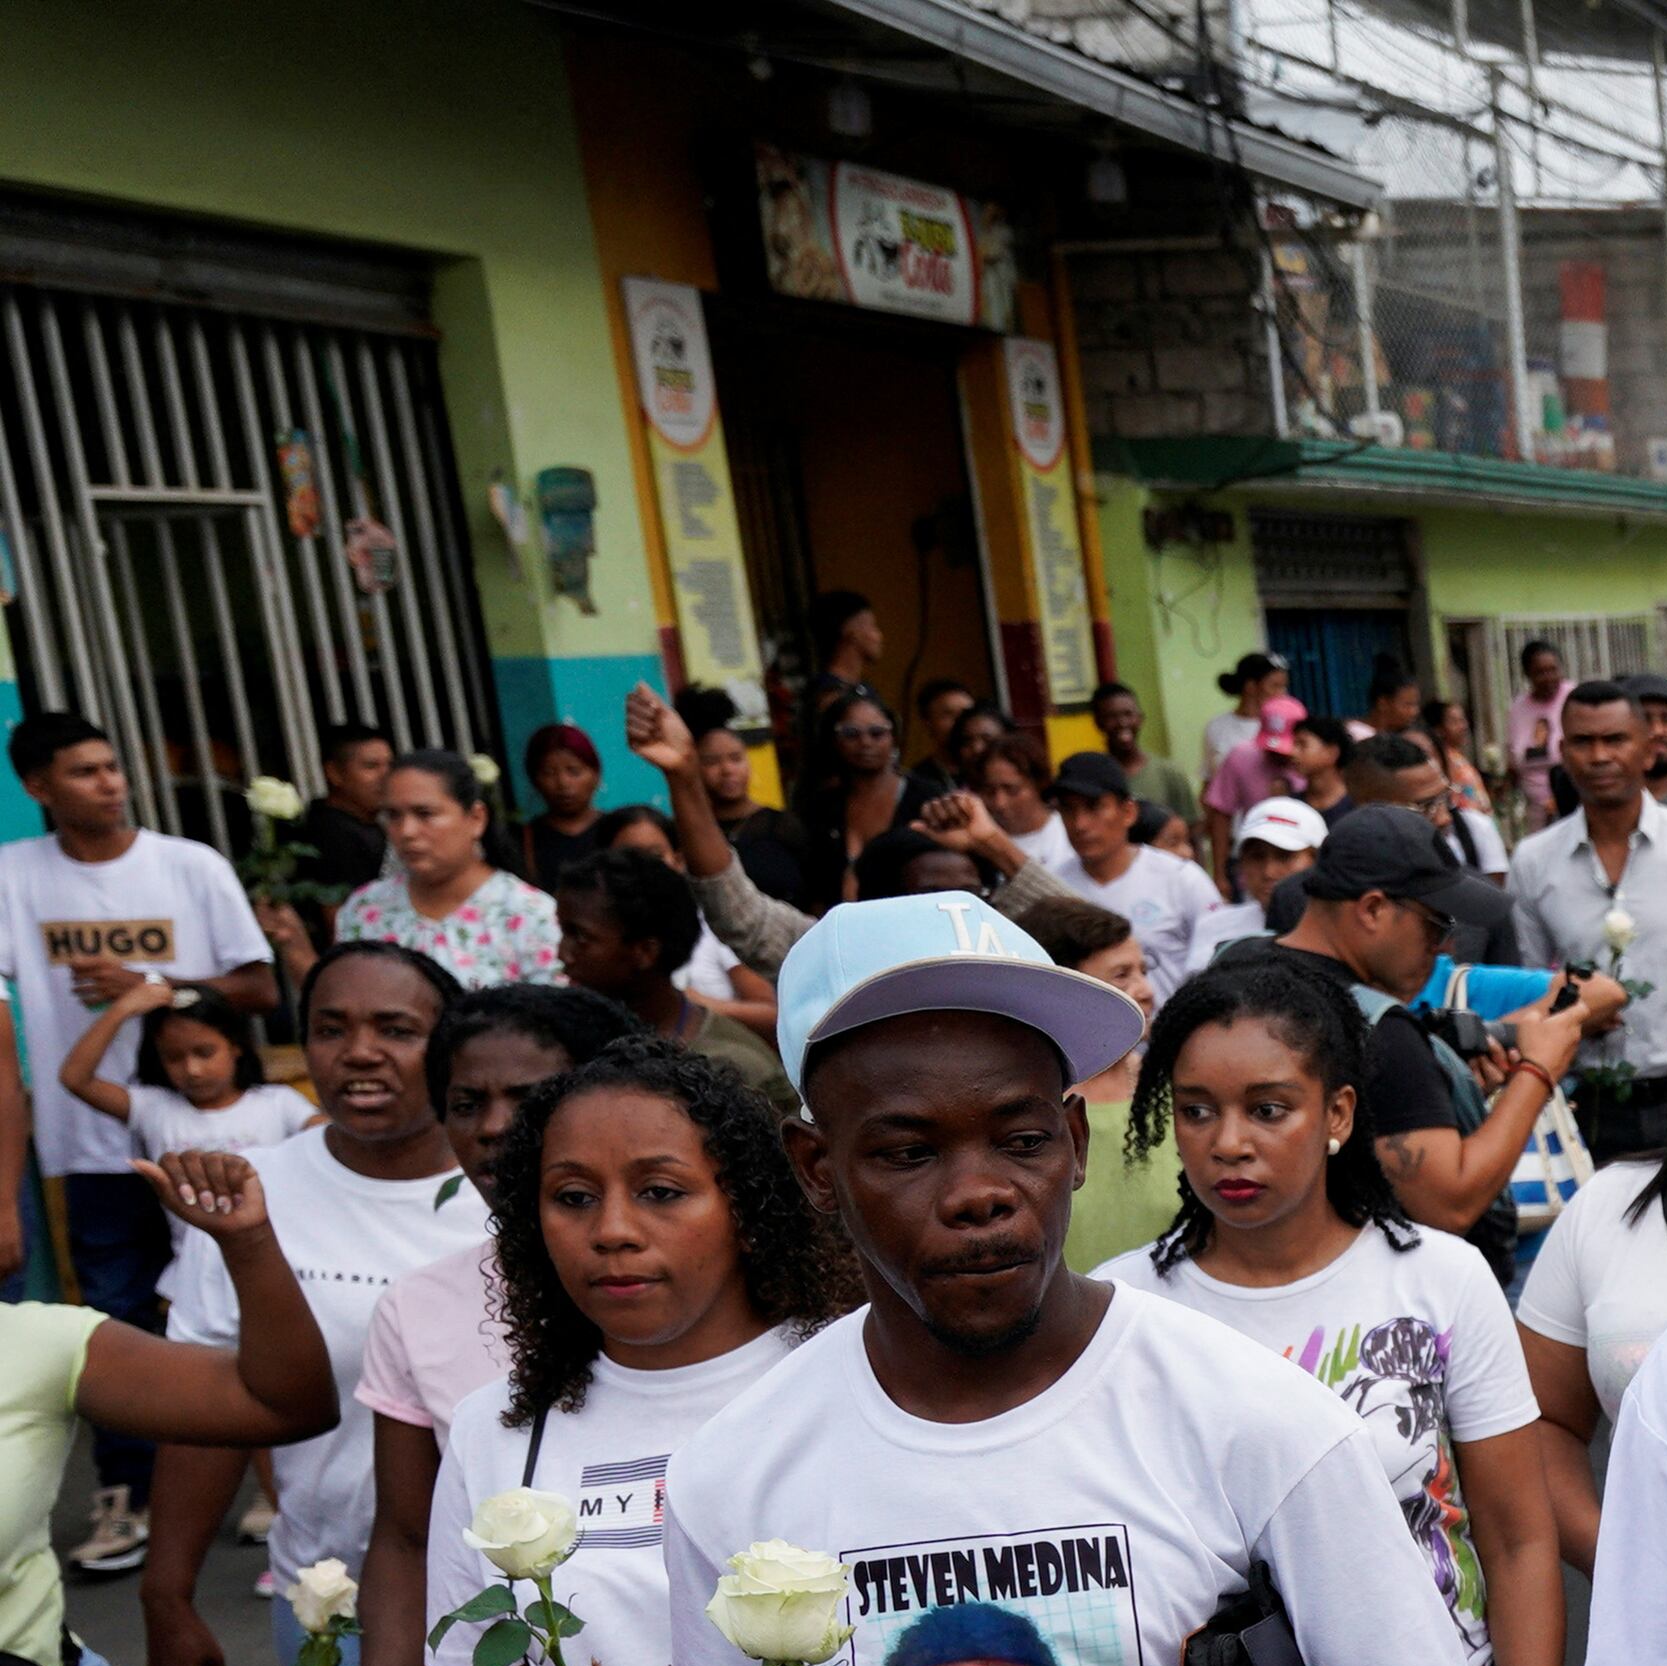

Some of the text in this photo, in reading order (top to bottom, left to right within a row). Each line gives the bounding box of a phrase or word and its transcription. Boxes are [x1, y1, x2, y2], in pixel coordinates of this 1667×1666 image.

[47, 927, 168, 958] HUGO
[853, 1535, 1129, 1616] STEVEN MEDINA
